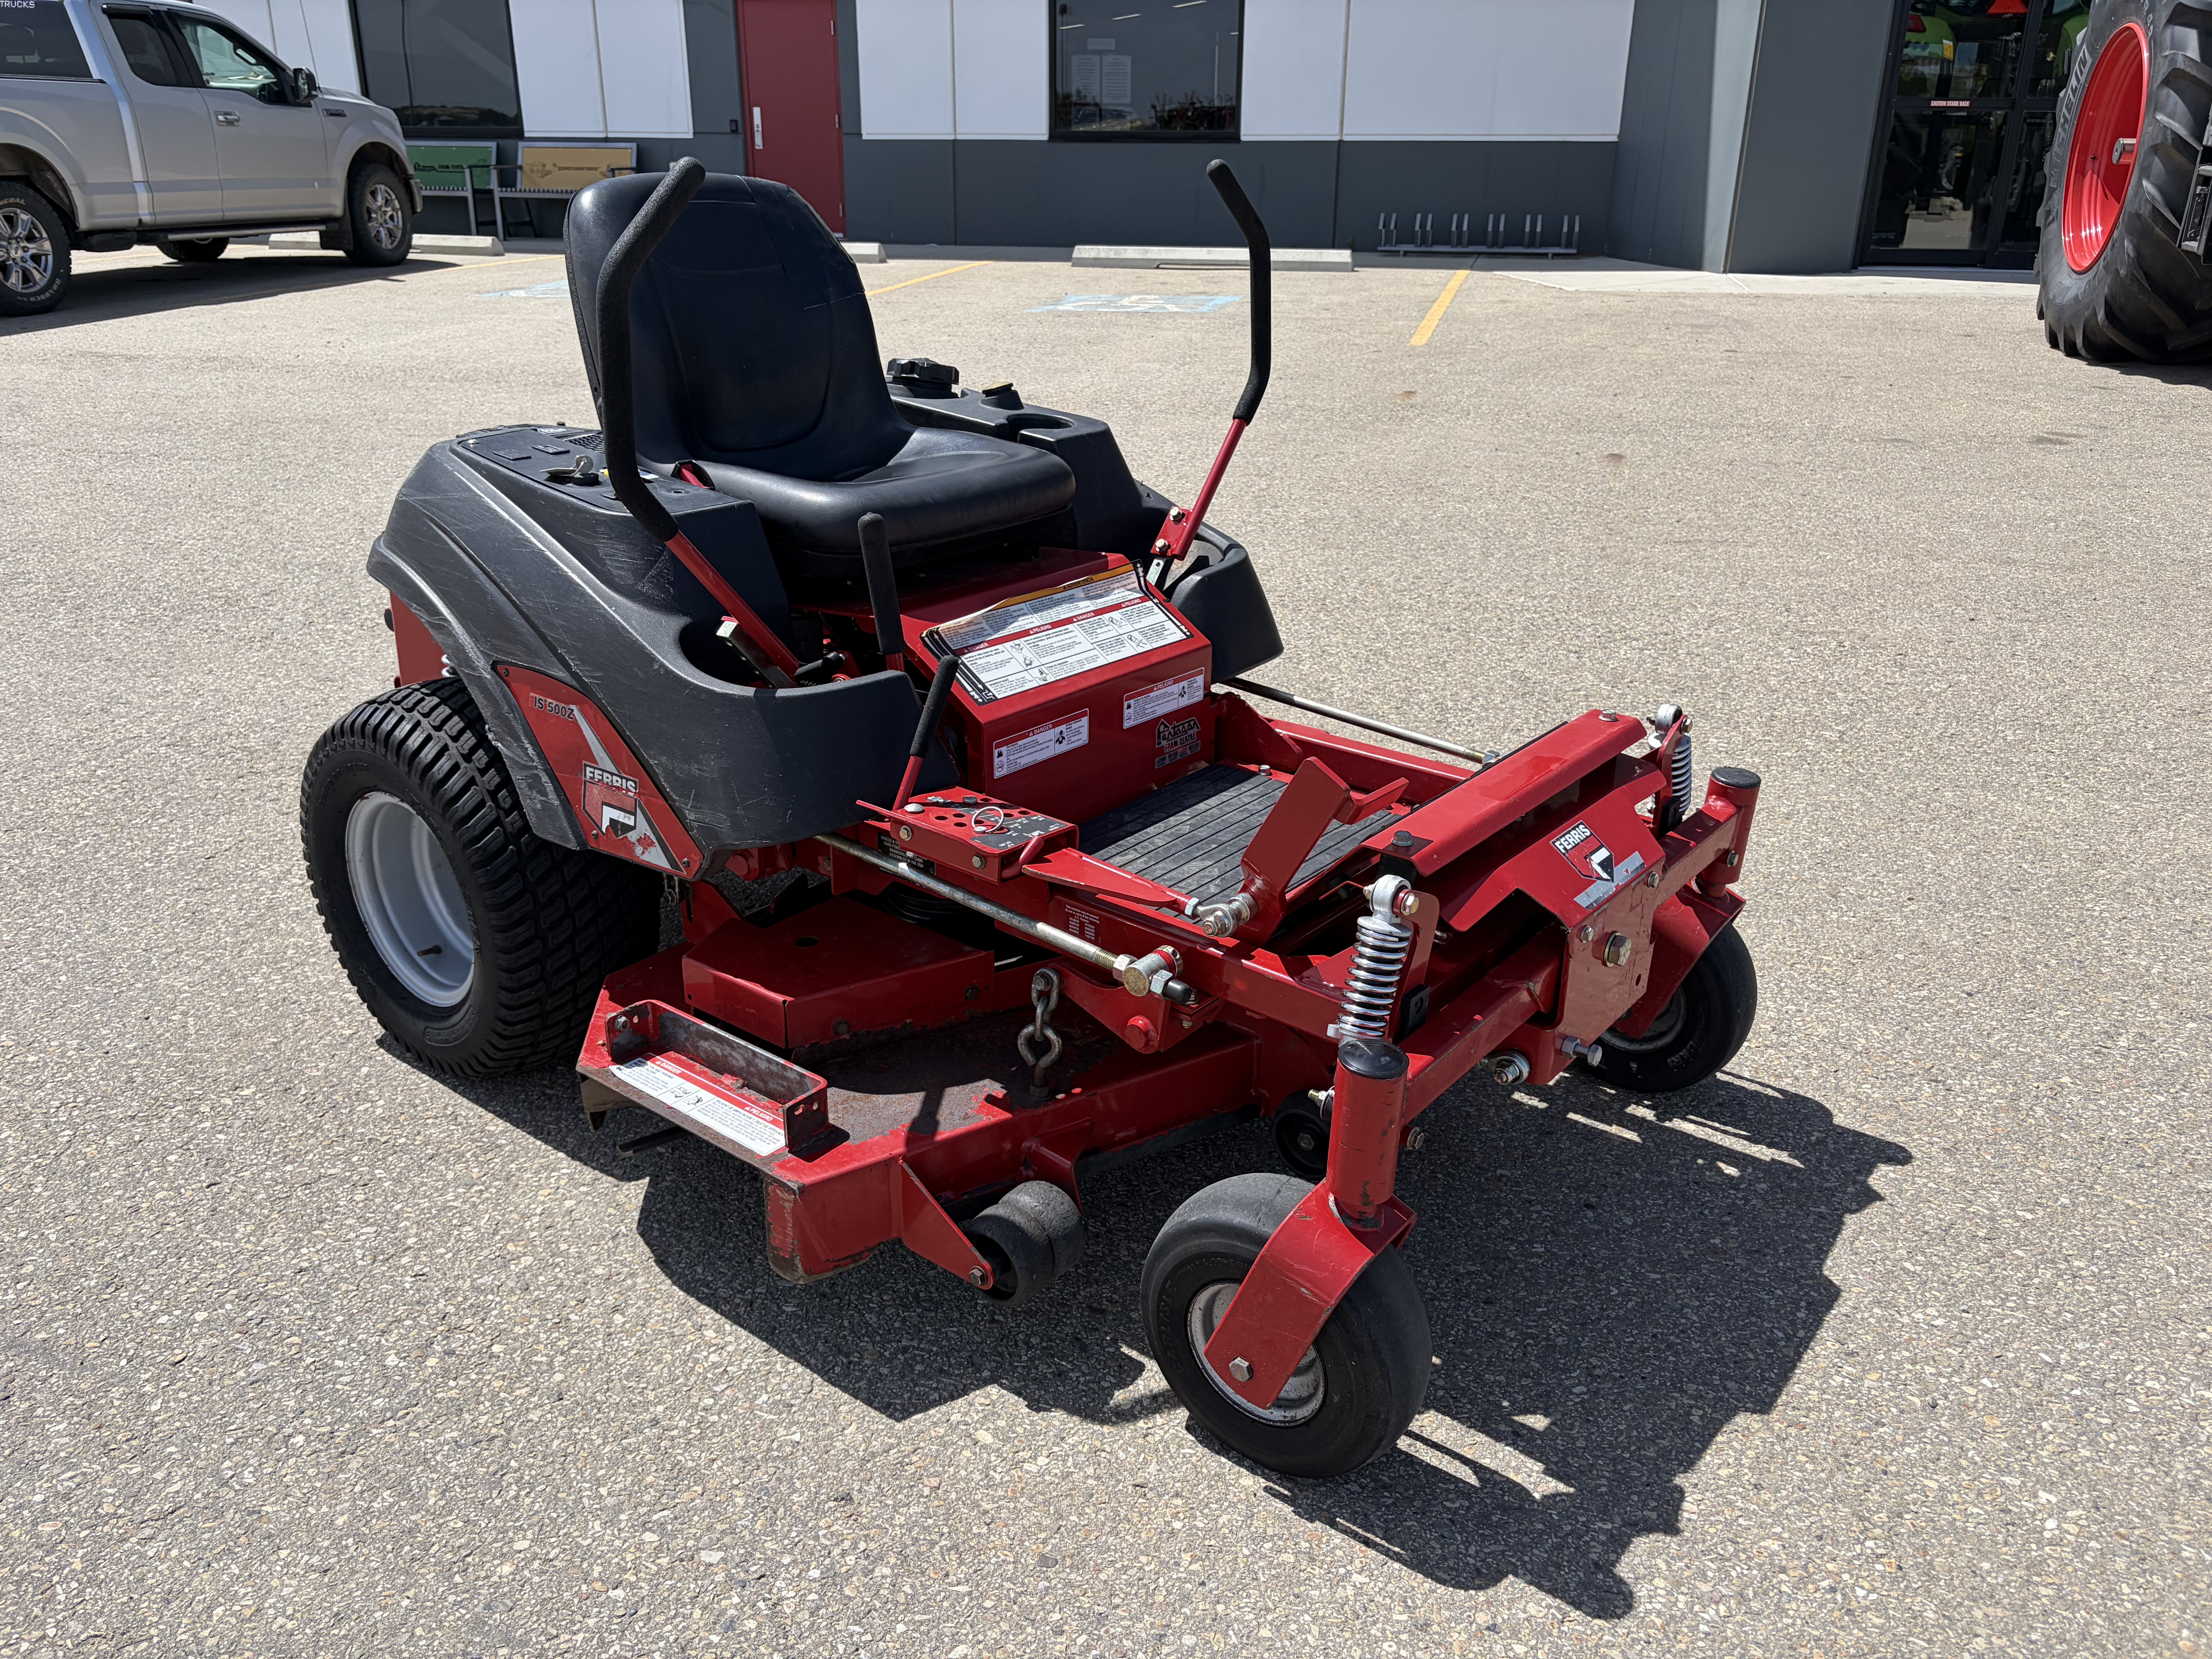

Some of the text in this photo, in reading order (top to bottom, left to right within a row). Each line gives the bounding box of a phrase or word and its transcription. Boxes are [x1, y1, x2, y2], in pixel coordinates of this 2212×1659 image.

[2050, 45, 2090, 188] MICHELIN
[1125, 598, 1141, 606] PELIGRO
[1077, 612, 1095, 620] DANGER
[1034, 625, 1052, 634] PELIGRO
[969, 642, 989, 652] DANGER
[1157, 680, 1174, 690] PELIGRO
[548, 701, 575, 720] 500Z
[1034, 723, 1053, 735] DANGER
[586, 766, 636, 793] FERRIS
[1554, 824, 1591, 854] FERRIS
[660, 1062, 682, 1074] DANGER
[749, 1108, 773, 1121] PELIGRO
[1159, 1279, 1184, 1374] CARLISLE
